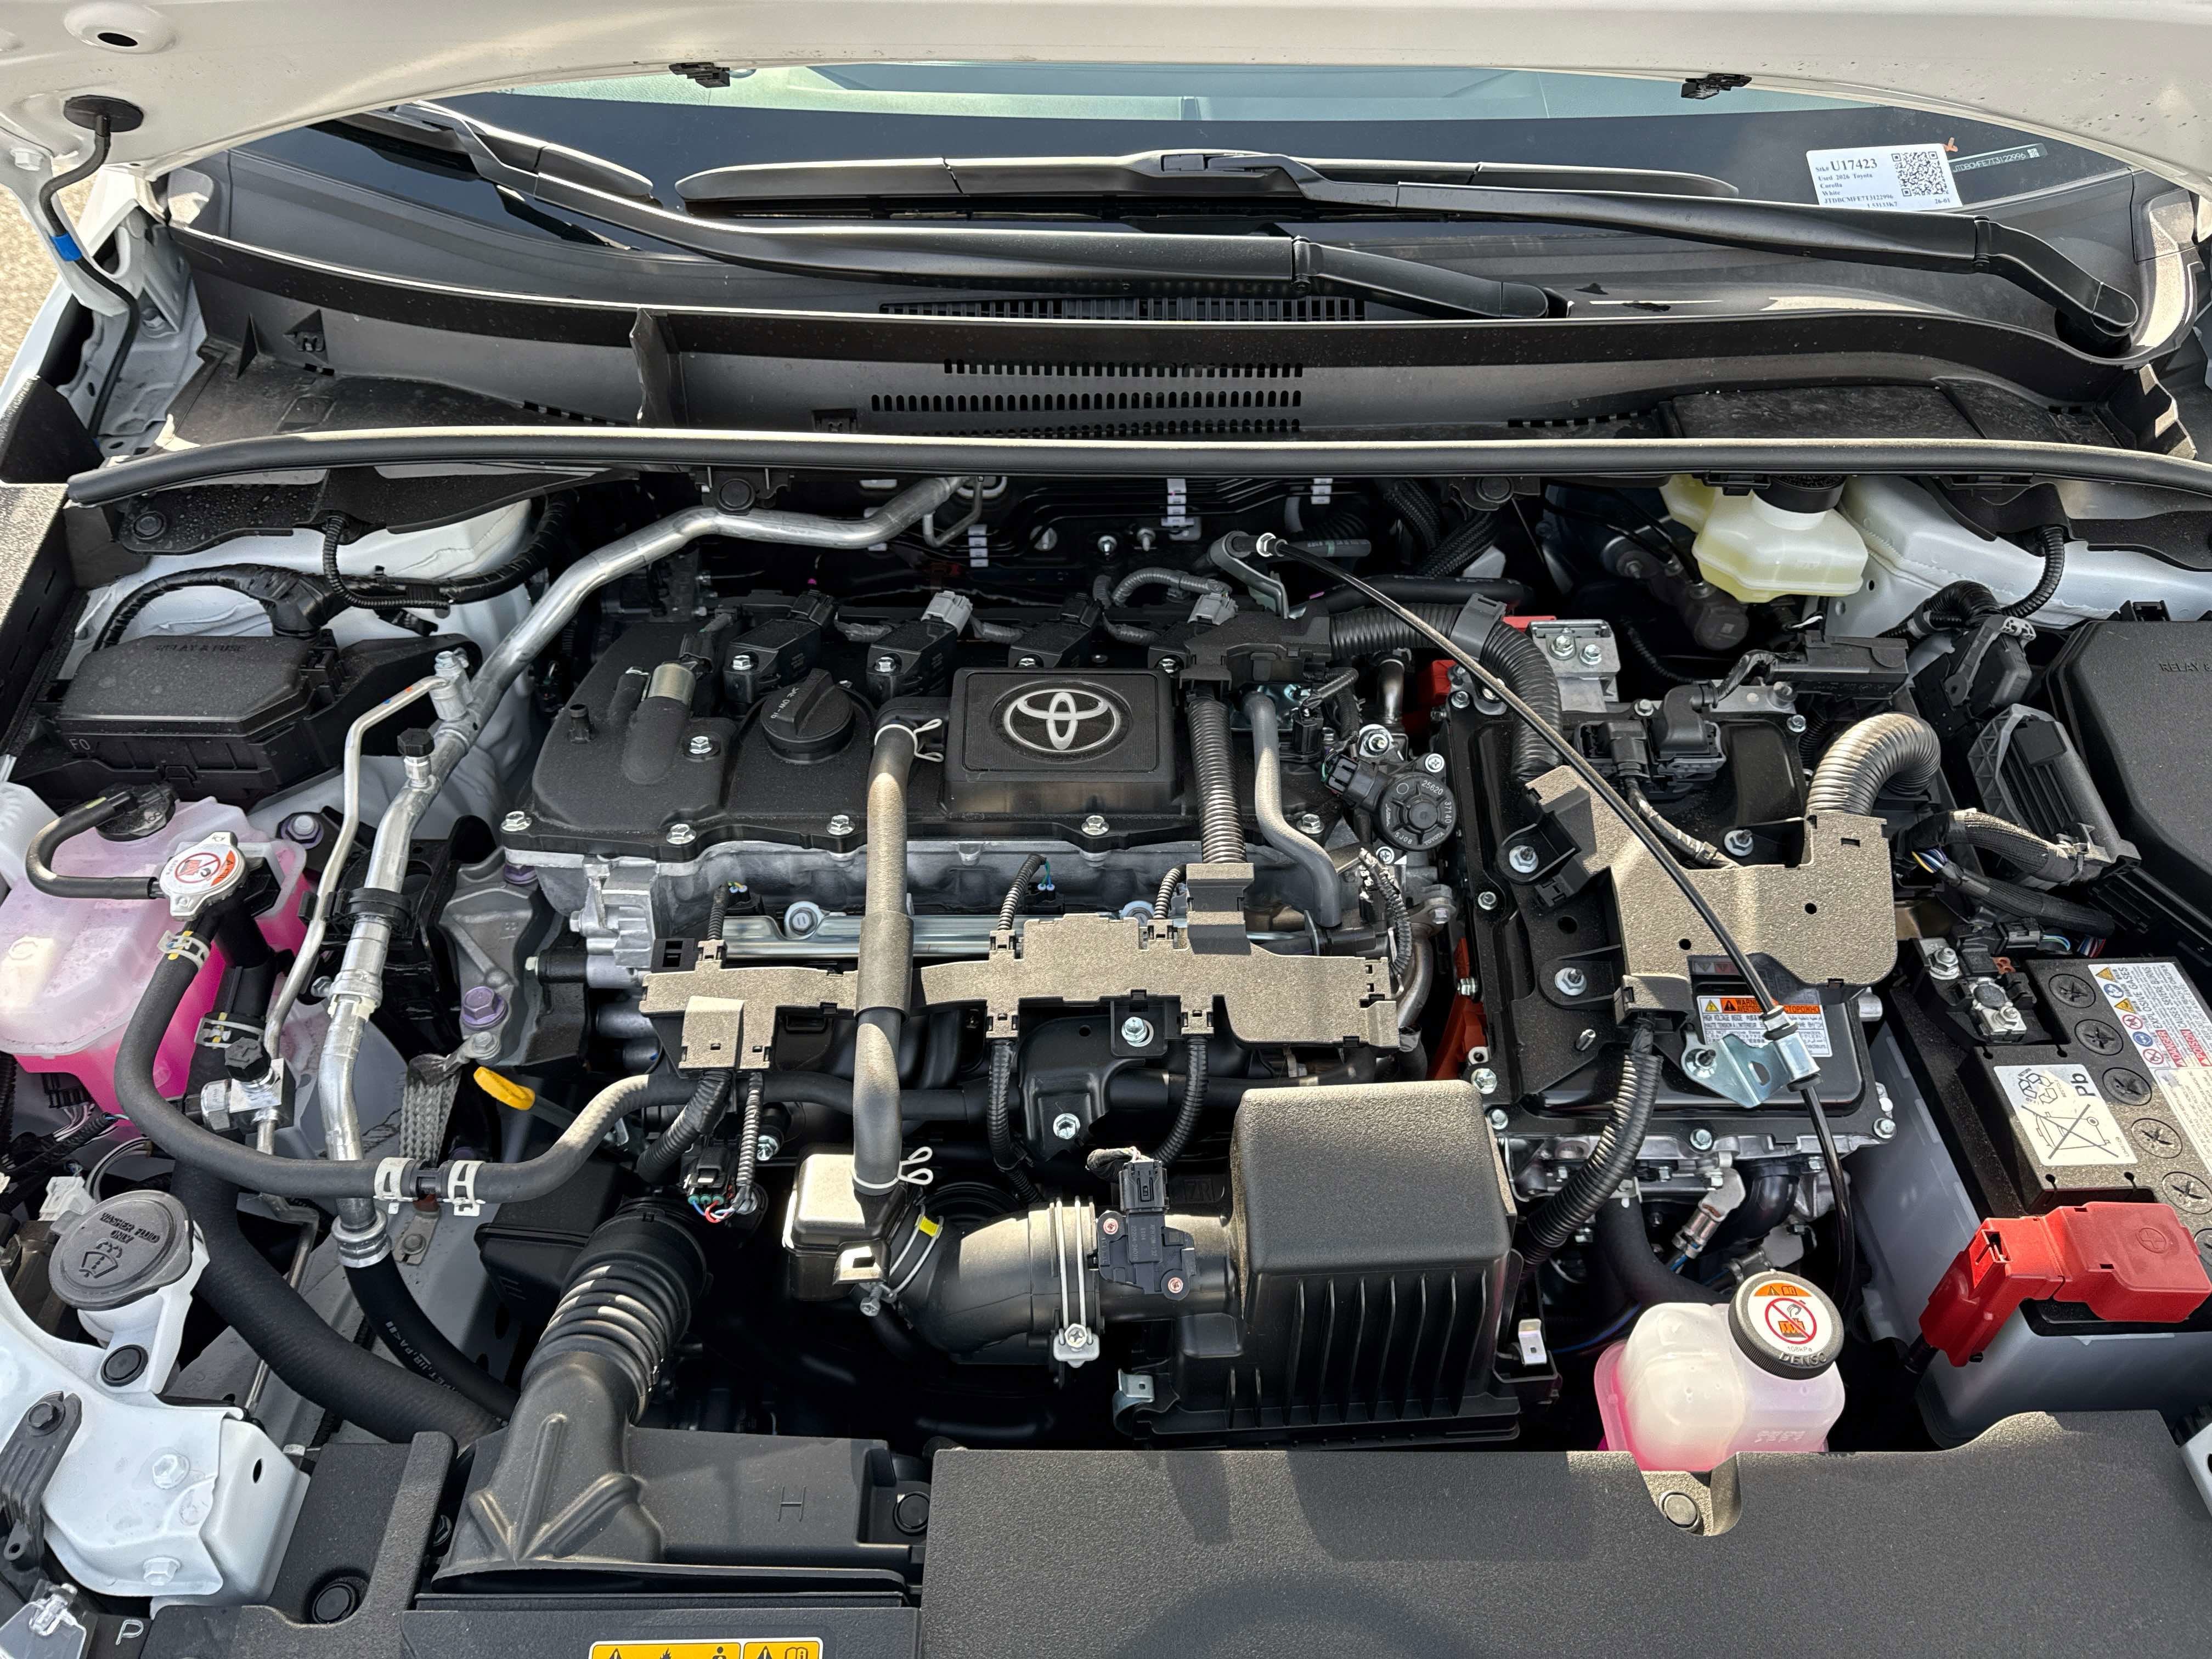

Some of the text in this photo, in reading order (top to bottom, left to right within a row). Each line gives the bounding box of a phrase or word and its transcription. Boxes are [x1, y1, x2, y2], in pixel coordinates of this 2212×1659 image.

[1830, 158, 1877, 171] U17423
[2159, 663, 2200, 672] RELAY
[1421, 780, 1444, 795] 25620
[1444, 801, 1453, 823] 37140
[1424, 832, 1445, 846] TOYOTA
[2118, 967, 2138, 990] GASES
[2142, 966, 2187, 1029] CAUSES SEVERE BURNS
[2132, 991, 2163, 1029] EXPLOSIVE
[2157, 1030, 2182, 1060] DANGER
[2181, 1030, 2207, 1059] POISON
[2070, 1073, 2096, 1096] Pb
[99, 1212, 161, 1244] WASHER FLUID
[110, 1229, 134, 1244] ONLY
[1779, 1352, 1827, 1366] DENSO
[778, 1484, 807, 1522] H
[116, 1618, 144, 1646] P
